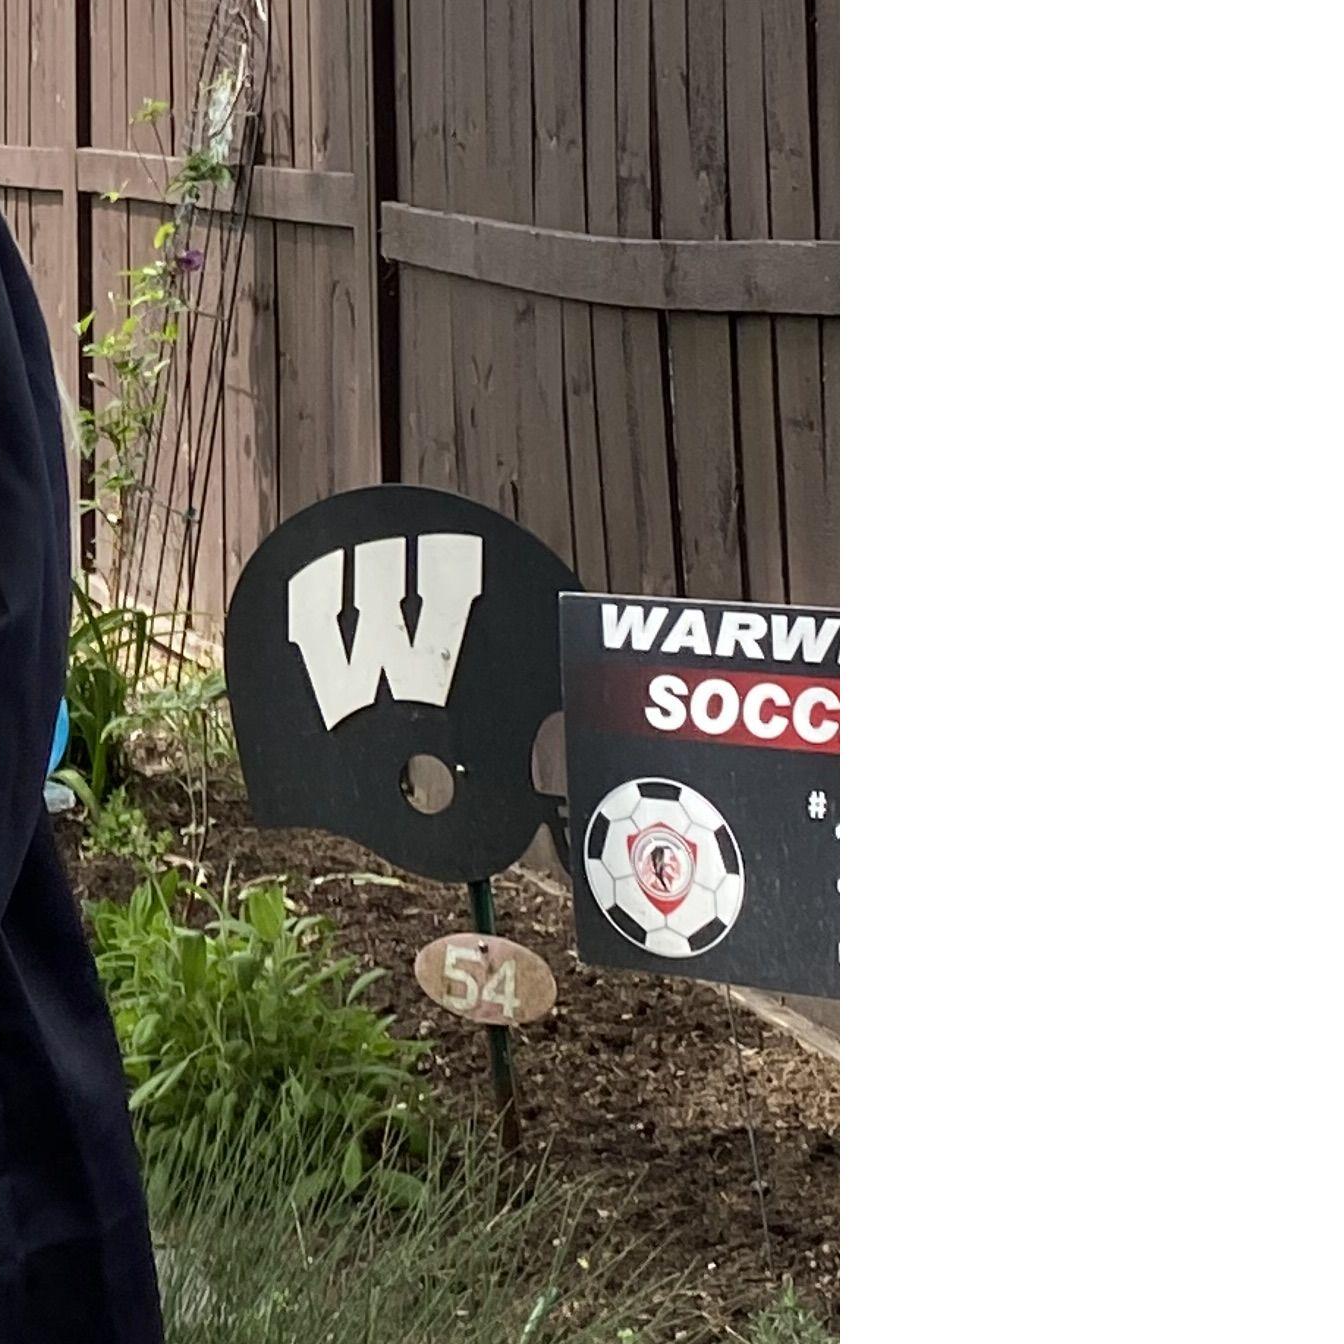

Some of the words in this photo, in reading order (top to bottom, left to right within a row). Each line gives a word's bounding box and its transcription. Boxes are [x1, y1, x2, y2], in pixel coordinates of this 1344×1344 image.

[288, 533, 483, 732] W
[601, 603, 840, 664] WARW
[442, 943, 521, 1018] 54
